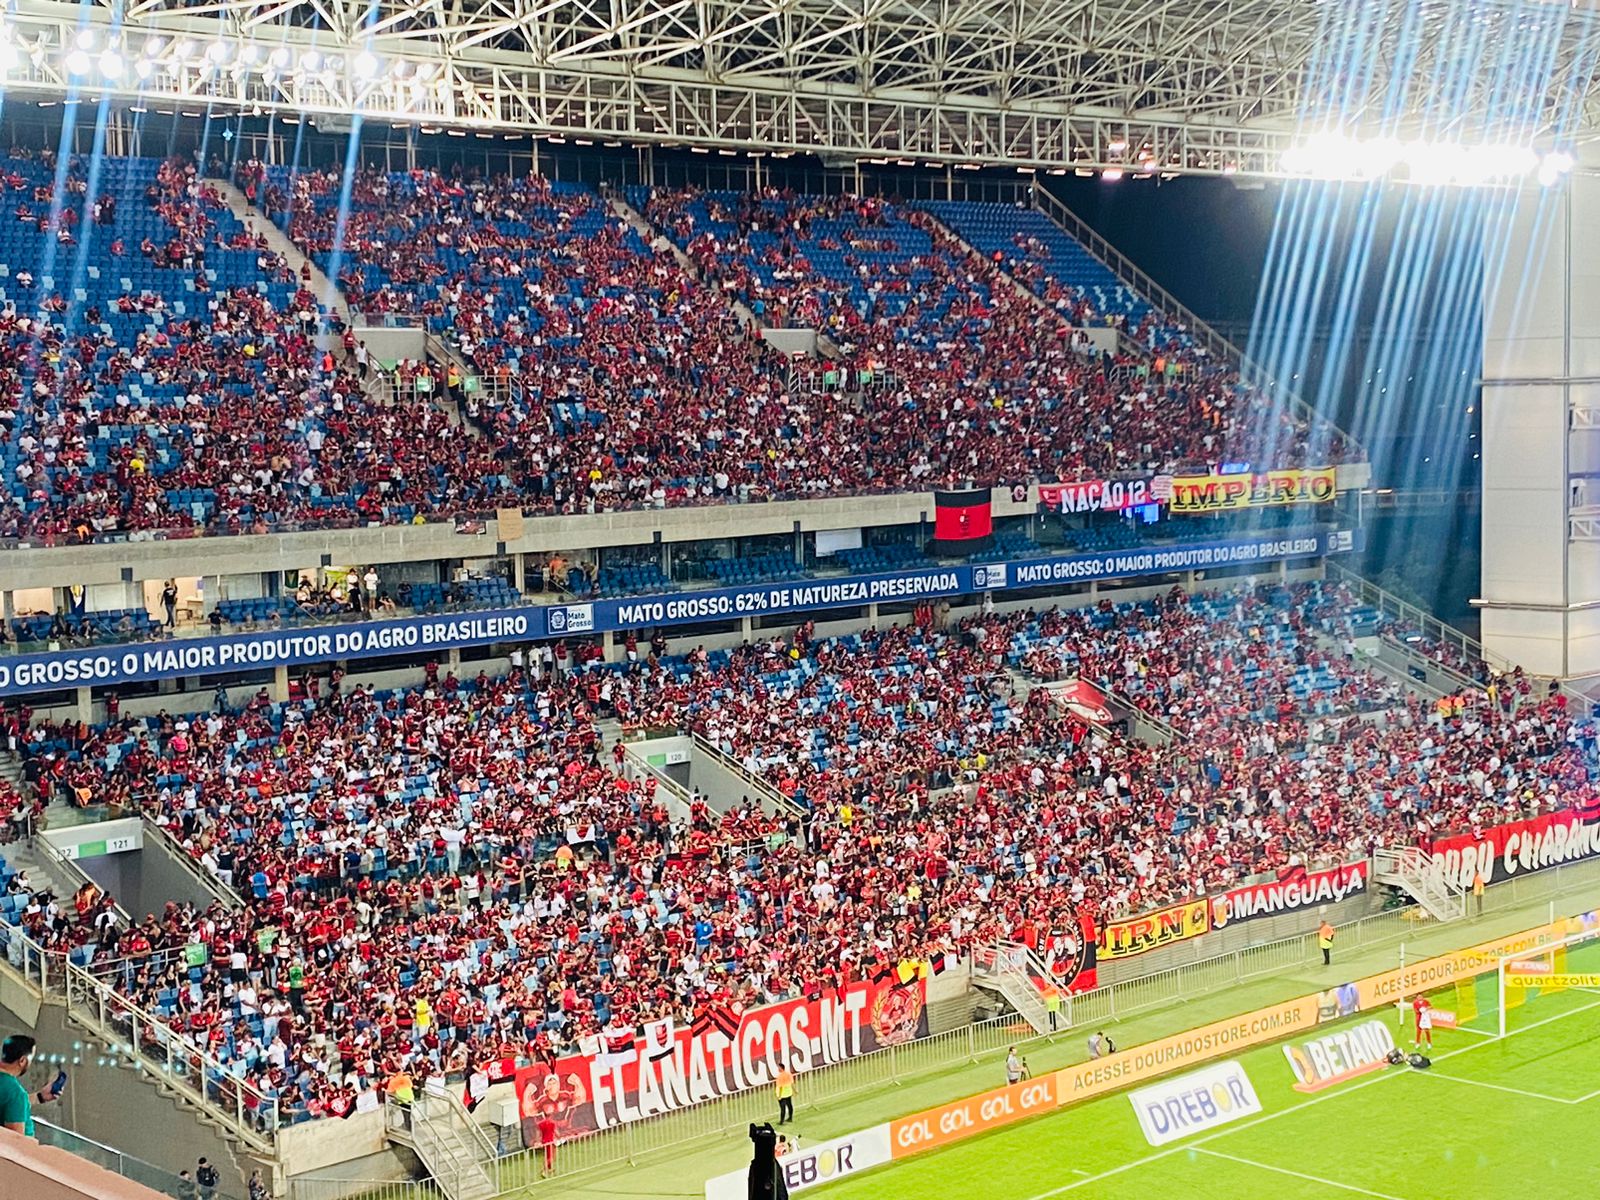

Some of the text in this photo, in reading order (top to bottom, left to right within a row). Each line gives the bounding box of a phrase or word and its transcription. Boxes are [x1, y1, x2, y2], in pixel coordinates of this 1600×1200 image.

[1060, 480, 1124, 513] NAÇÃO
[1128, 480, 1146, 505] 12
[1017, 564, 1052, 583] MATO
[1054, 560, 1103, 579] GROSSO:
[1106, 558, 1114, 571] O
[1116, 553, 1152, 571] MAIOR
[1154, 548, 1211, 569] PRODUTOR
[1214, 546, 1228, 562] DO
[1229, 544, 1257, 561] AGRO
[1259, 538, 1317, 558] BRASILEIRO
[568, 620, 592, 628] Grosso
[618, 573, 958, 624] MATO GROSSO: 62% DE NATUREZA PRESERVADA
[15, 659, 117, 686] GROSSO:
[123, 655, 139, 672] O
[143, 645, 215, 670] MAIOR
[219, 634, 331, 664] PRODUTOR
[335, 631, 363, 653] DO
[365, 626, 418, 650] AGRO
[422, 616, 528, 645] BRASILEIRO
[113, 839, 128, 849] 121
[1234, 868, 1363, 920] MANGUAÇA
[1374, 972, 1417, 998] ACESSE
[1074, 1008, 1301, 1091] ACESSE DOURADOSTORE.COM.BR
[1304, 1020, 1395, 1080] BETANO
[898, 1082, 1053, 1147] GOL GOL GOL GOL
[1146, 1075, 1251, 1135] DREBOR
[785, 1143, 853, 1189] EBOR
